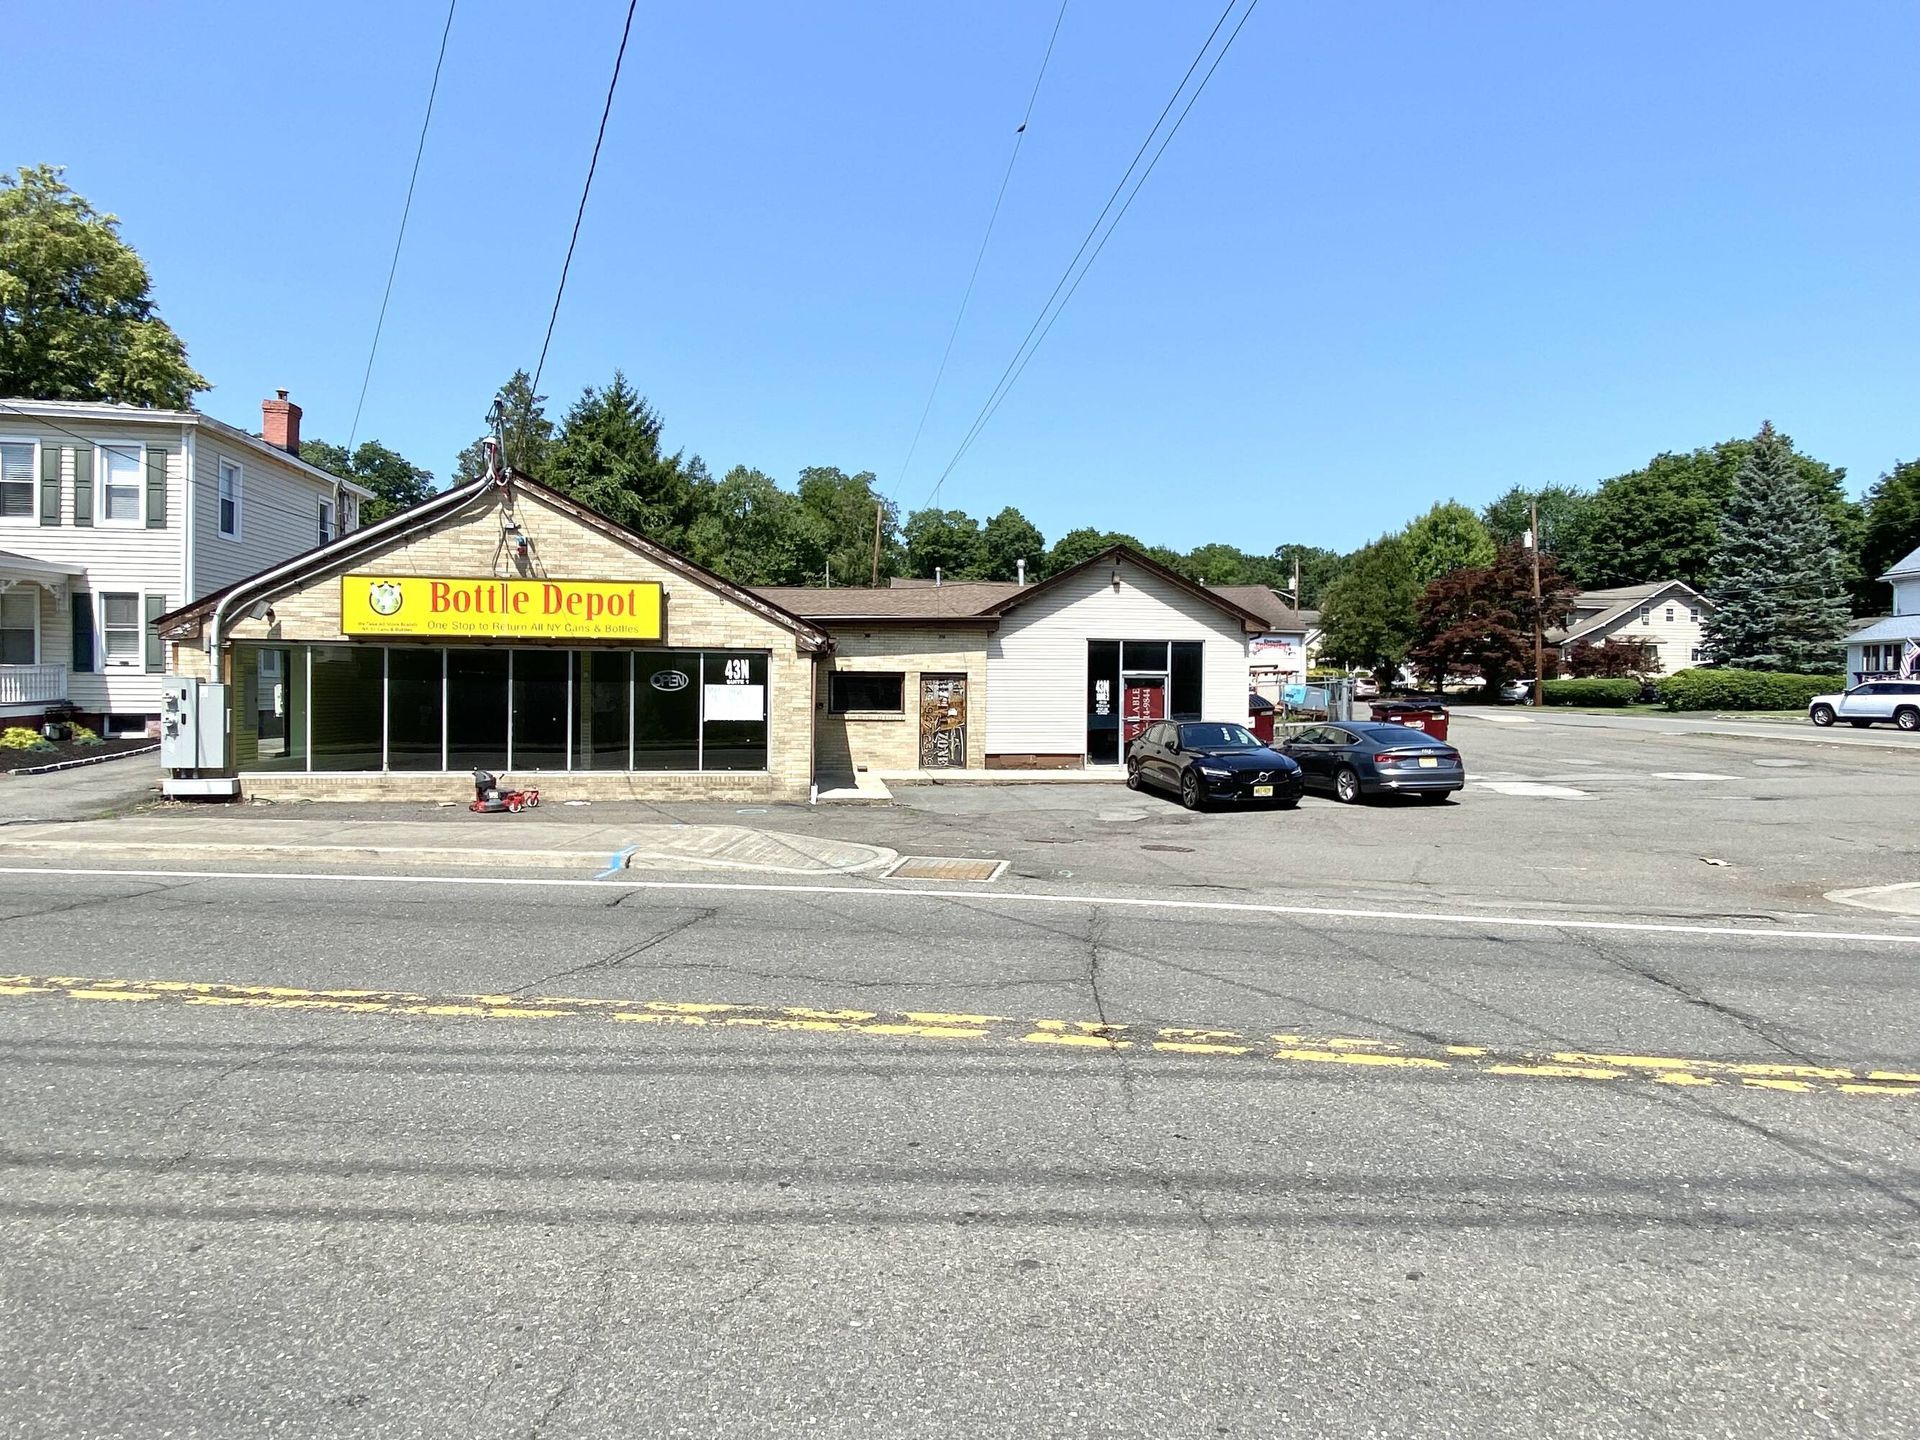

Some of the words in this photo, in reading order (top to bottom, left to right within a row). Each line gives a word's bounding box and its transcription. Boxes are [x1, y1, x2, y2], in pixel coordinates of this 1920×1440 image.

[430, 581, 529, 614] Bottle
[543, 583, 637, 620] Depot
[427, 620, 448, 630] One
[452, 621, 476, 633] Stop
[479, 622, 488, 631] to
[492, 622, 528, 632] Return
[531, 623, 544, 632] All
[547, 623, 561, 633] NY
[564, 623, 590, 633] Cans
[594, 624, 602, 633] &
[605, 624, 640, 635] Bottles
[725, 659, 750, 680] 43N
[654, 674, 685, 687] OPEN
[1132, 688, 1140, 736] VAILABLE
